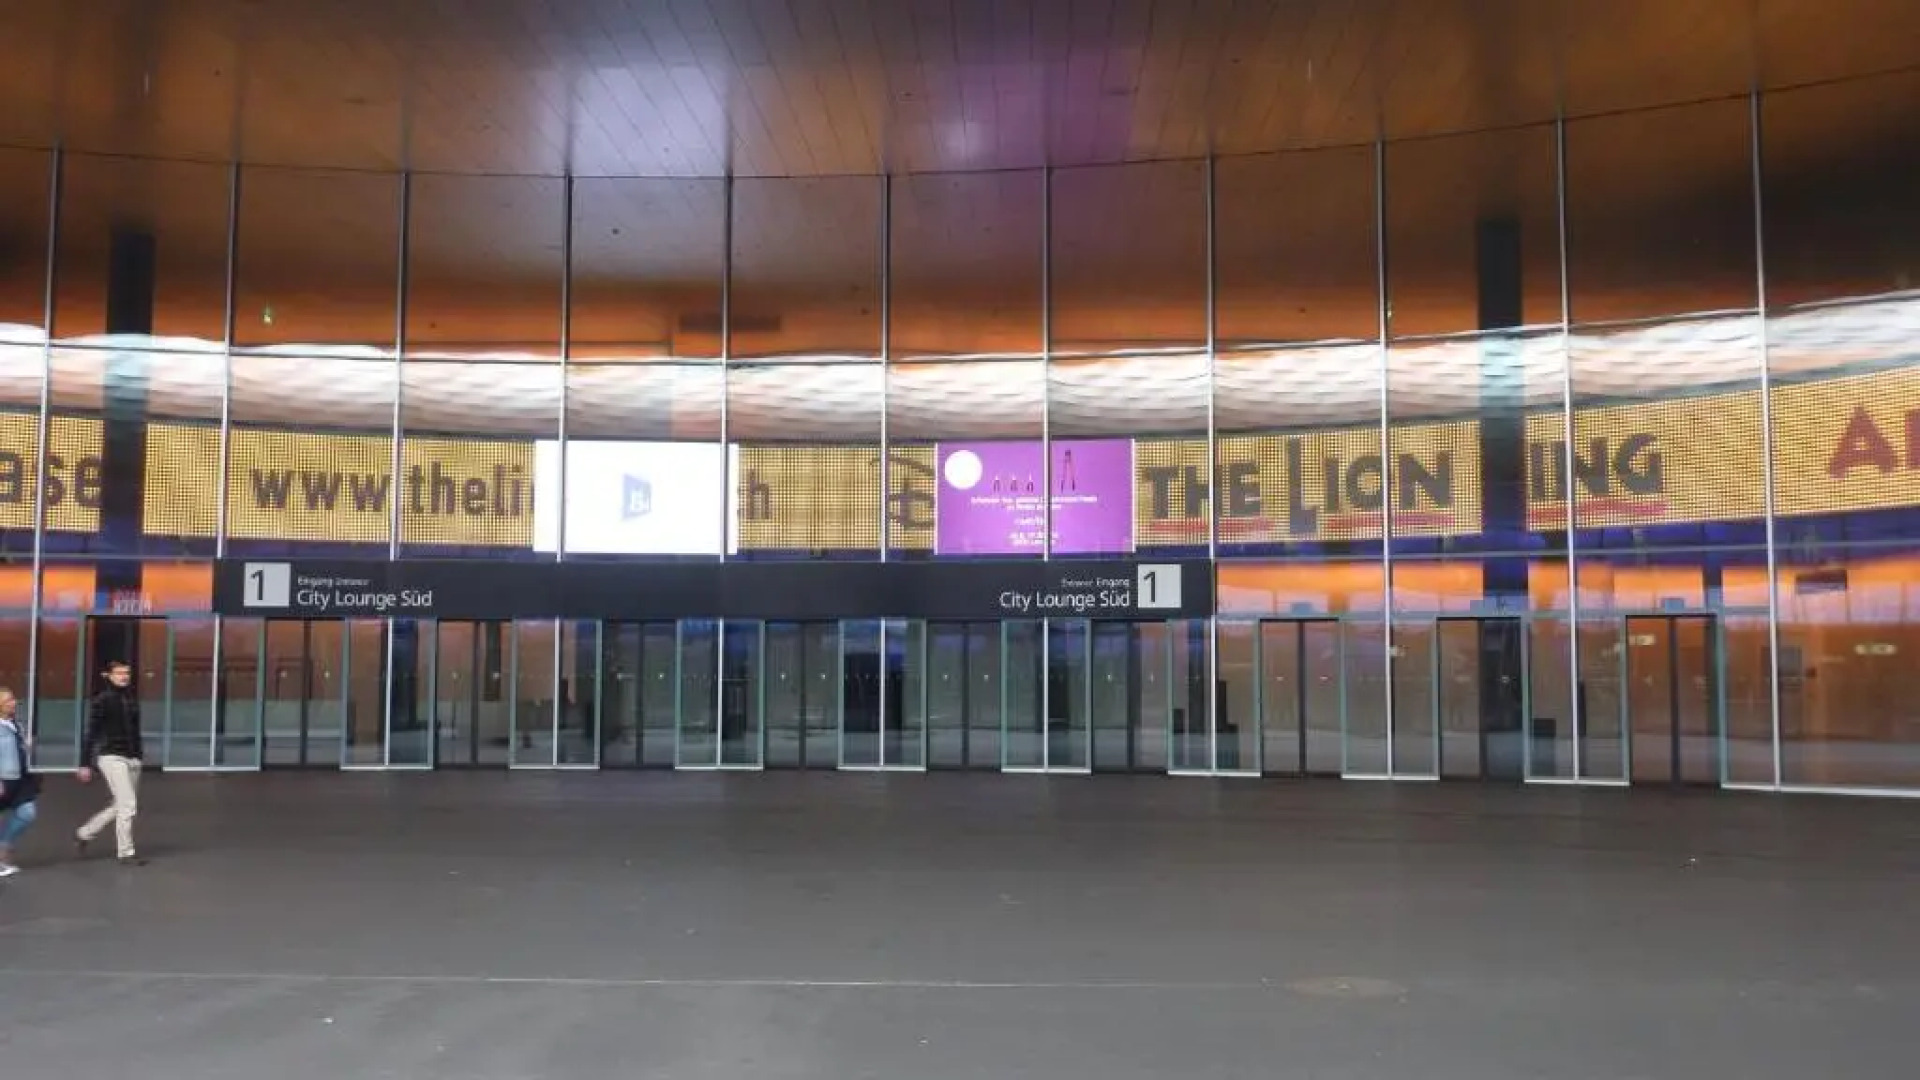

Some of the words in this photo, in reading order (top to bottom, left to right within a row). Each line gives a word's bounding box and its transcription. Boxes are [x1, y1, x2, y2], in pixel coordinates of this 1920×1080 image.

[1141, 462, 1261, 519] THE
[1289, 437, 1454, 535] LION
[1530, 432, 1664, 500] ING
[250, 569, 264, 601] 1
[297, 589, 331, 611] City
[335, 590, 396, 611] Lounge
[401, 589, 433, 607] Süd
[999, 590, 1032, 612] City
[1036, 590, 1095, 612] Lounge
[1100, 589, 1130, 608] Süd
[1143, 571, 1156, 603] 1
